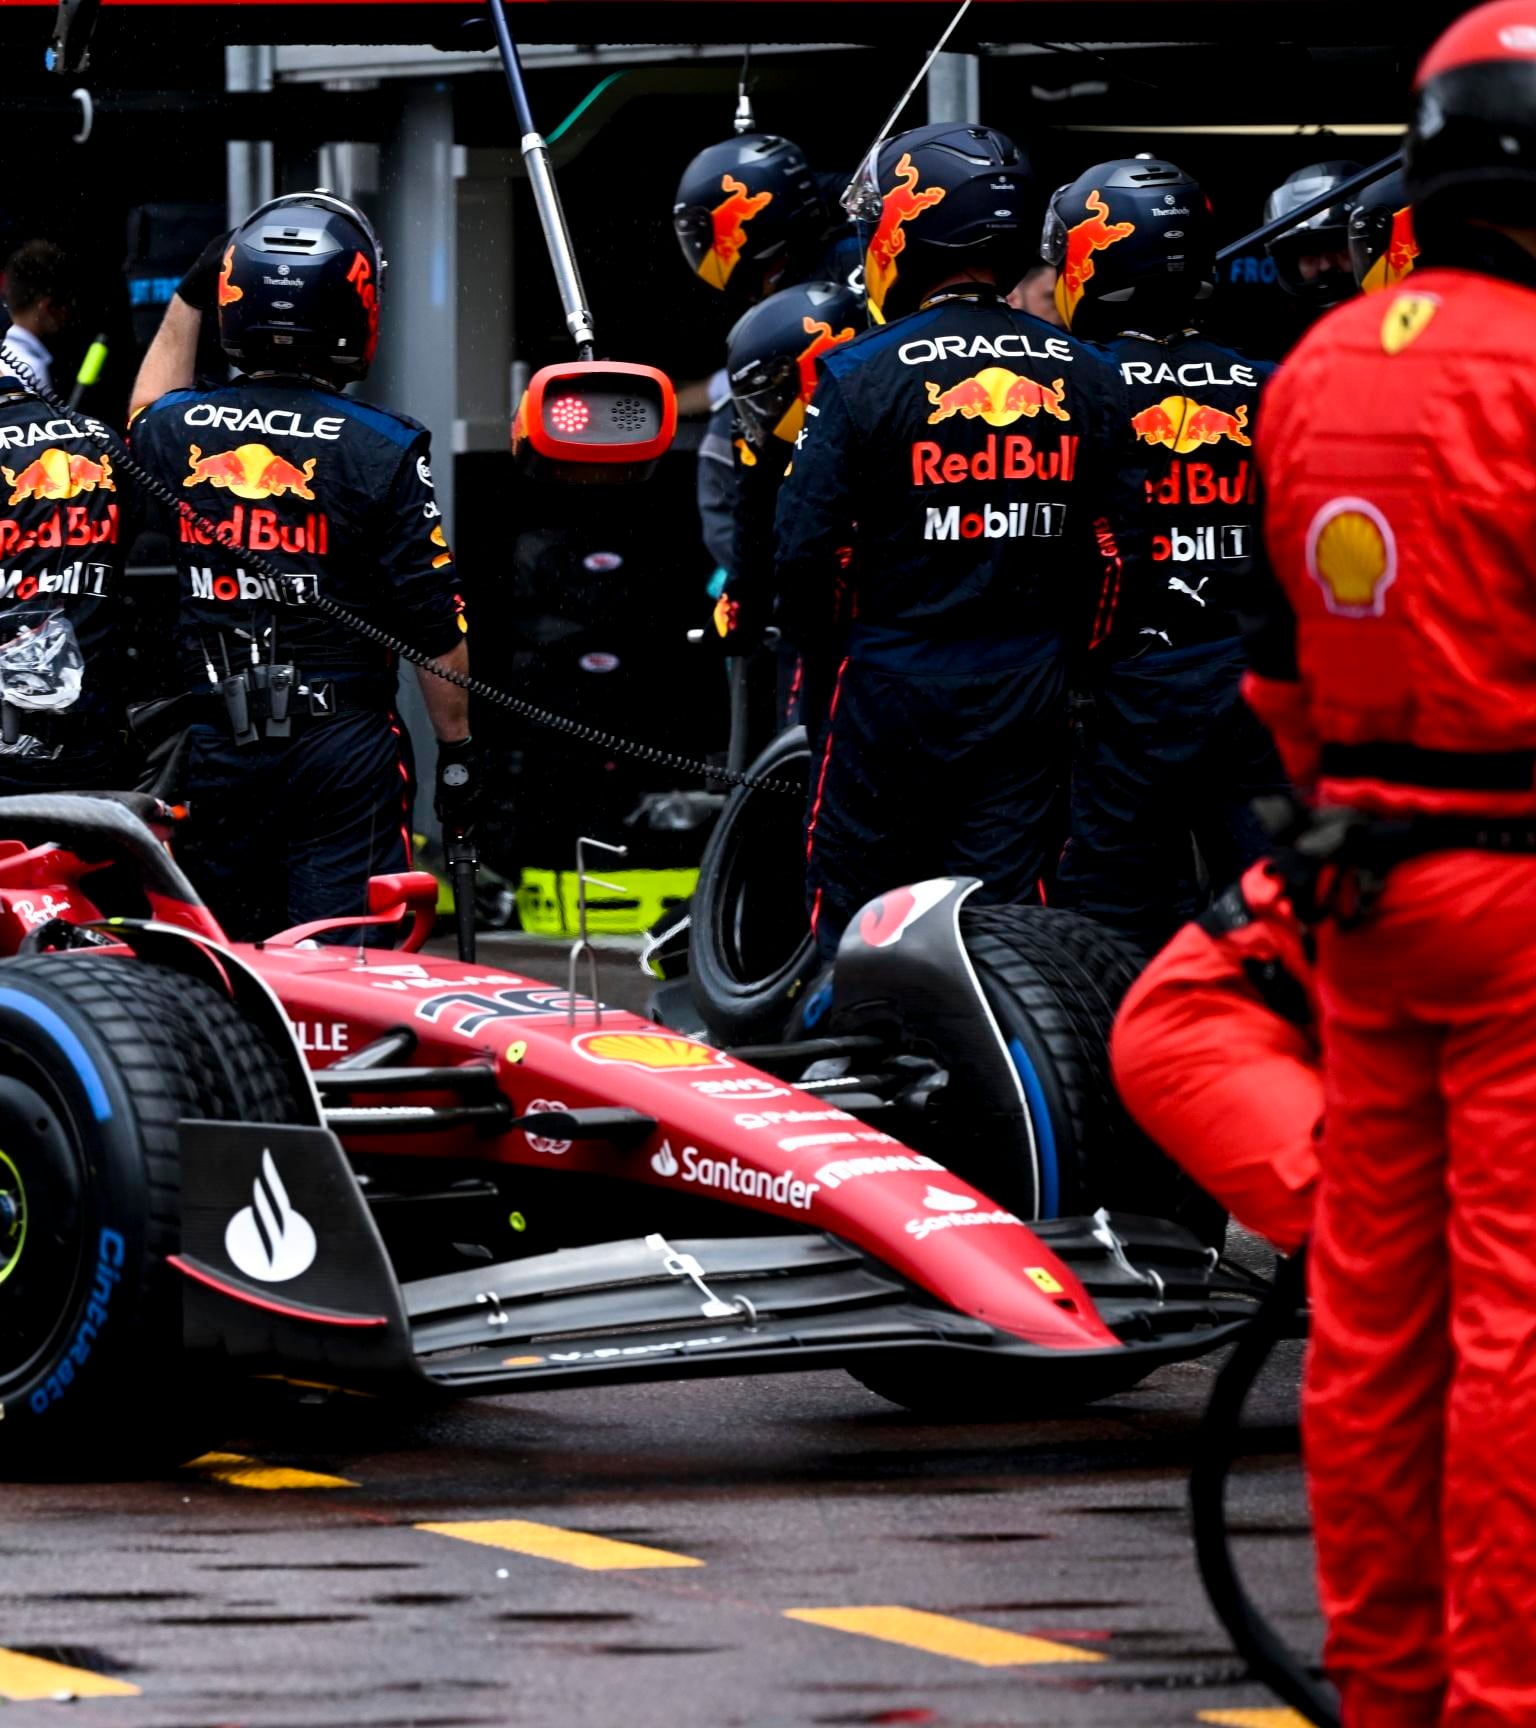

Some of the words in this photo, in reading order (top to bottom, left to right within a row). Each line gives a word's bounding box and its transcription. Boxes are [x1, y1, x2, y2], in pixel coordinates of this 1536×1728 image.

[898, 335, 1074, 365] ORACLE
[1119, 361, 1258, 388] RACLE
[184, 404, 346, 440] ORACLE
[911, 435, 998, 486] Red
[1003, 435, 1080, 482] Bull
[179, 501, 245, 549] Red
[249, 508, 330, 555] Bull
[924, 503, 1030, 541] Mobil
[190, 565, 280, 602] Mobil
[414, 987, 626, 1038] 16
[681, 1147, 820, 1210] Santander
[30, 1227, 125, 1414] Cinturato
